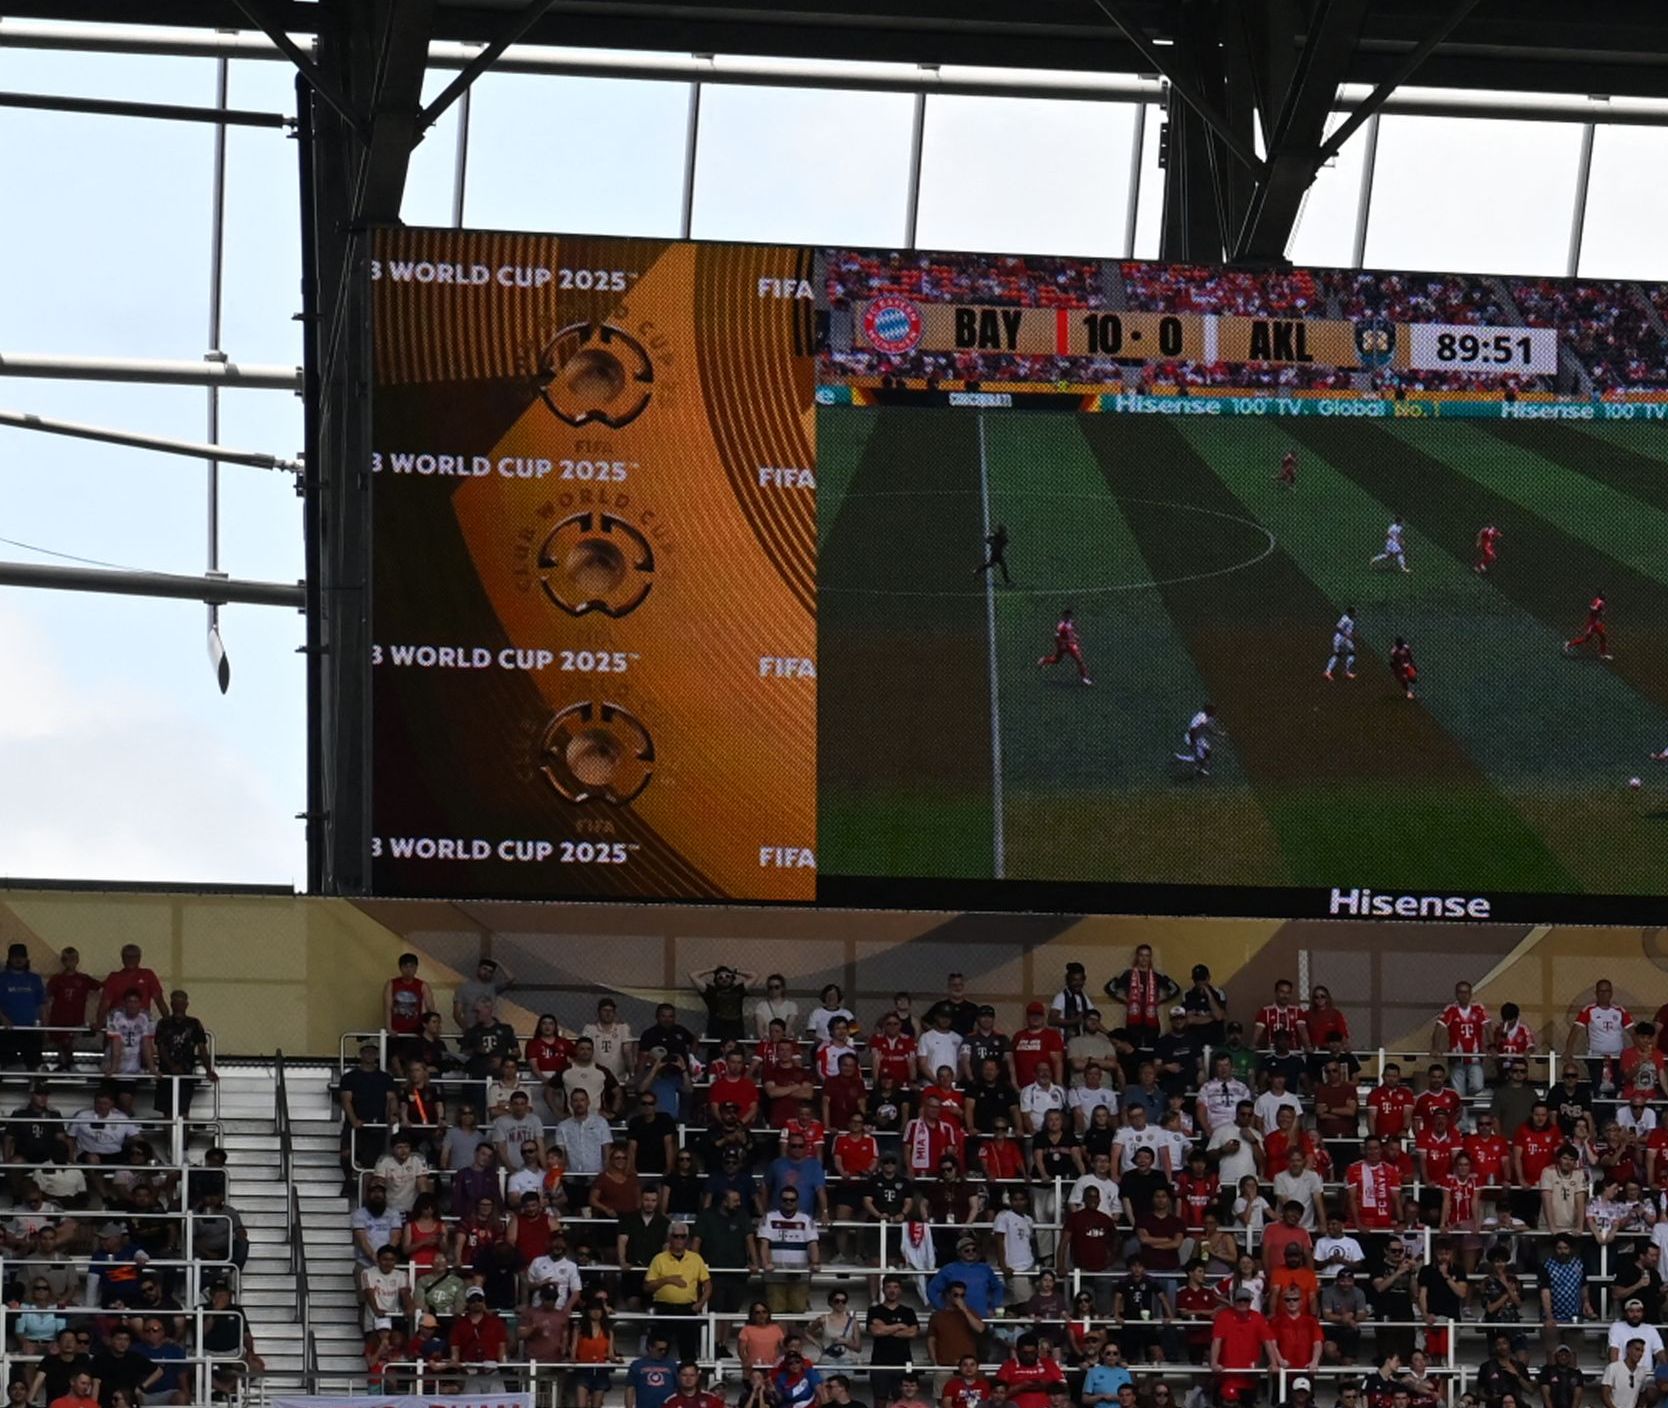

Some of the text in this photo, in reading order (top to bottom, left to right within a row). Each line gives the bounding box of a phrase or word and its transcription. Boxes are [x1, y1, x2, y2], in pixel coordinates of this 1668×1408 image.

[391, 261, 492, 286] WORLD
[497, 266, 551, 288] CUP
[758, 277, 814, 300] FIFA
[954, 308, 1313, 362] BAY 10 0 AKL
[1436, 332, 1532, 364] 89:51
[1115, 394, 1221, 414] Hisense
[1318, 398, 1386, 416] Global
[1501, 402, 1594, 419] Hisense
[391, 454, 491, 478] WORLD
[498, 457, 552, 479] CUP
[759, 468, 815, 490] FIFA
[392, 646, 491, 669] WORLD
[499, 648, 553, 671] CUP
[759, 657, 816, 678] FIFA
[392, 839, 491, 860] WORLD
[499, 841, 553, 862] CUP
[759, 847, 816, 868] FIFA
[1330, 886, 1491, 918] Hisense
